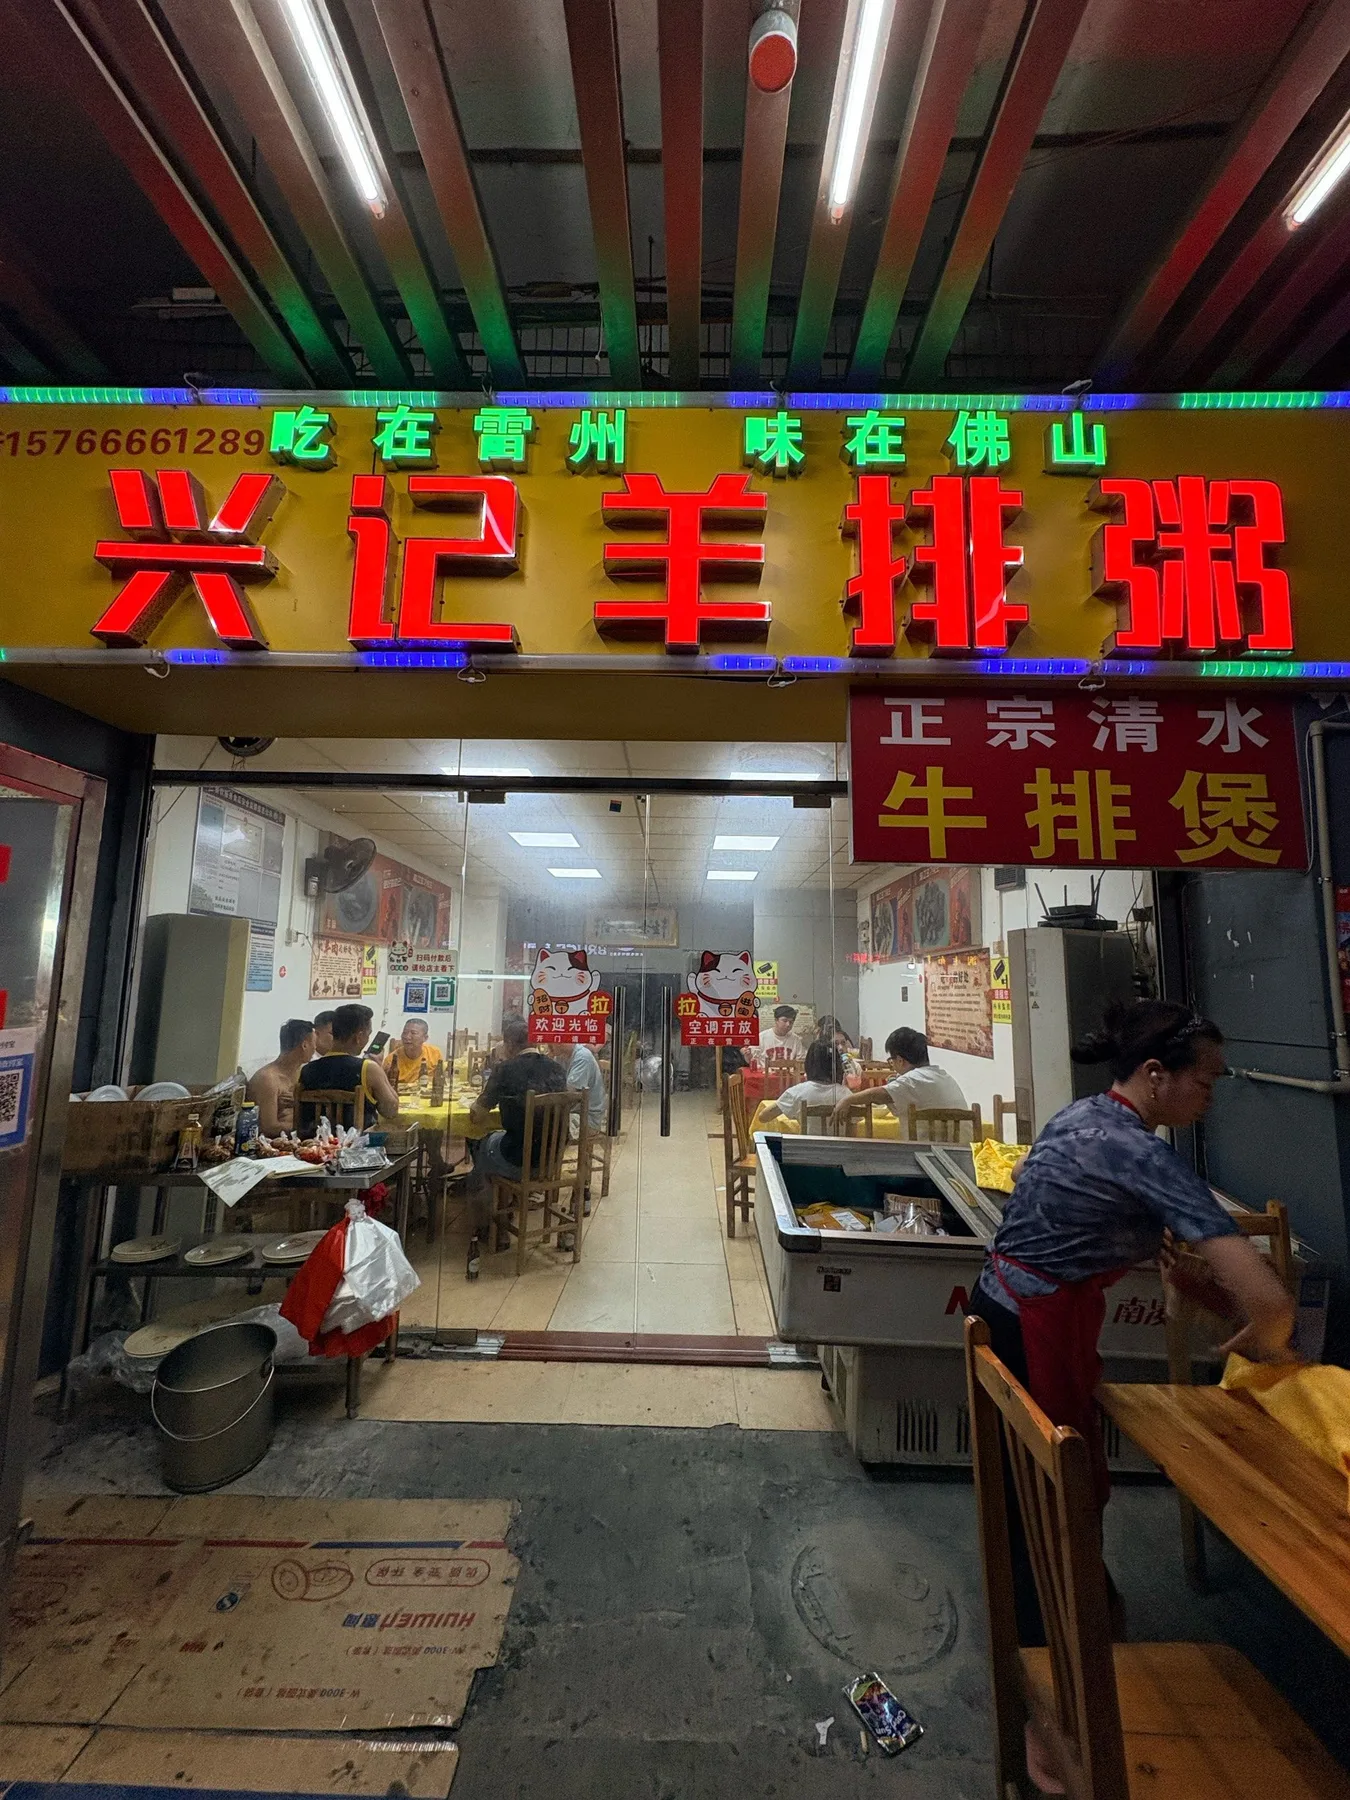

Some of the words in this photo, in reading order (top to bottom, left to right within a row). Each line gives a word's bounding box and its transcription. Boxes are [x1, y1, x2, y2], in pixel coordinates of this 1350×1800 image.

[6, 428, 265, 457] 15766661289
[270, 405, 627, 463] 吃在雷州
[743, 409, 1107, 467] 味在佛山
[90, 469, 1295, 654] 兴记羊排粥
[879, 695, 1270, 753] 正宗清水
[878, 766, 1283, 864] 牛排煲
[590, 995, 610, 1014] 拉
[677, 997, 697, 1016] 拉
[535, 1017, 598, 1032] 欢迎光临
[688, 1020, 752, 1035] 空调开放
[536, 1035, 597, 1043] 开门请进
[689, 1037, 751, 1045] 正在营业
